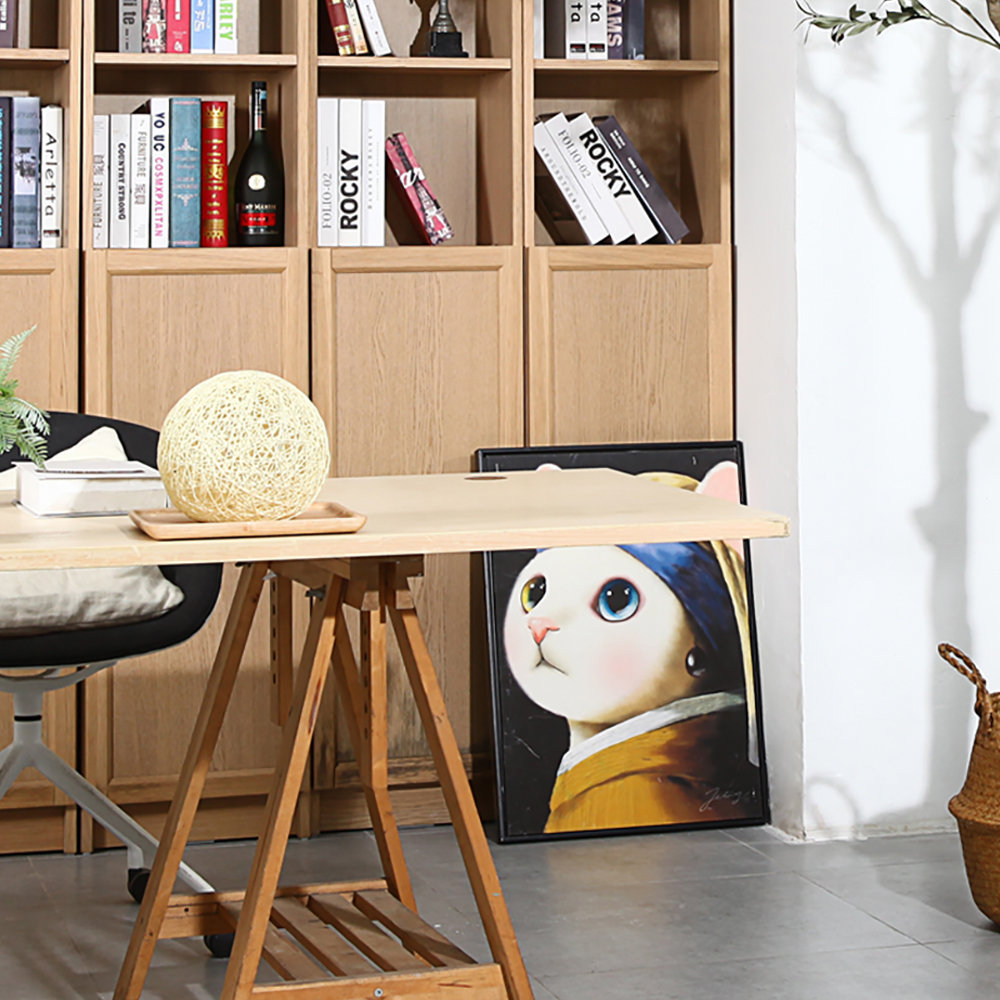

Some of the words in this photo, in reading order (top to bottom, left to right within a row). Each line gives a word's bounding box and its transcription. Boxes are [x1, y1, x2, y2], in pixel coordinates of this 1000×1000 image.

[123, 12, 136, 24] te
[154, 113, 165, 128] YO
[154, 135, 165, 151] UC
[45, 132, 57, 216] Arletta
[118, 143, 126, 183] COUNTRY
[137, 132, 146, 177] FURNITURE
[558, 129, 592, 179] FOLIO-02
[579, 129, 632, 199] ROCKY
[118, 185, 126, 220] STRONG
[322, 173, 332, 229] FOLIO-02
[340, 150, 358, 229] ROCKY
